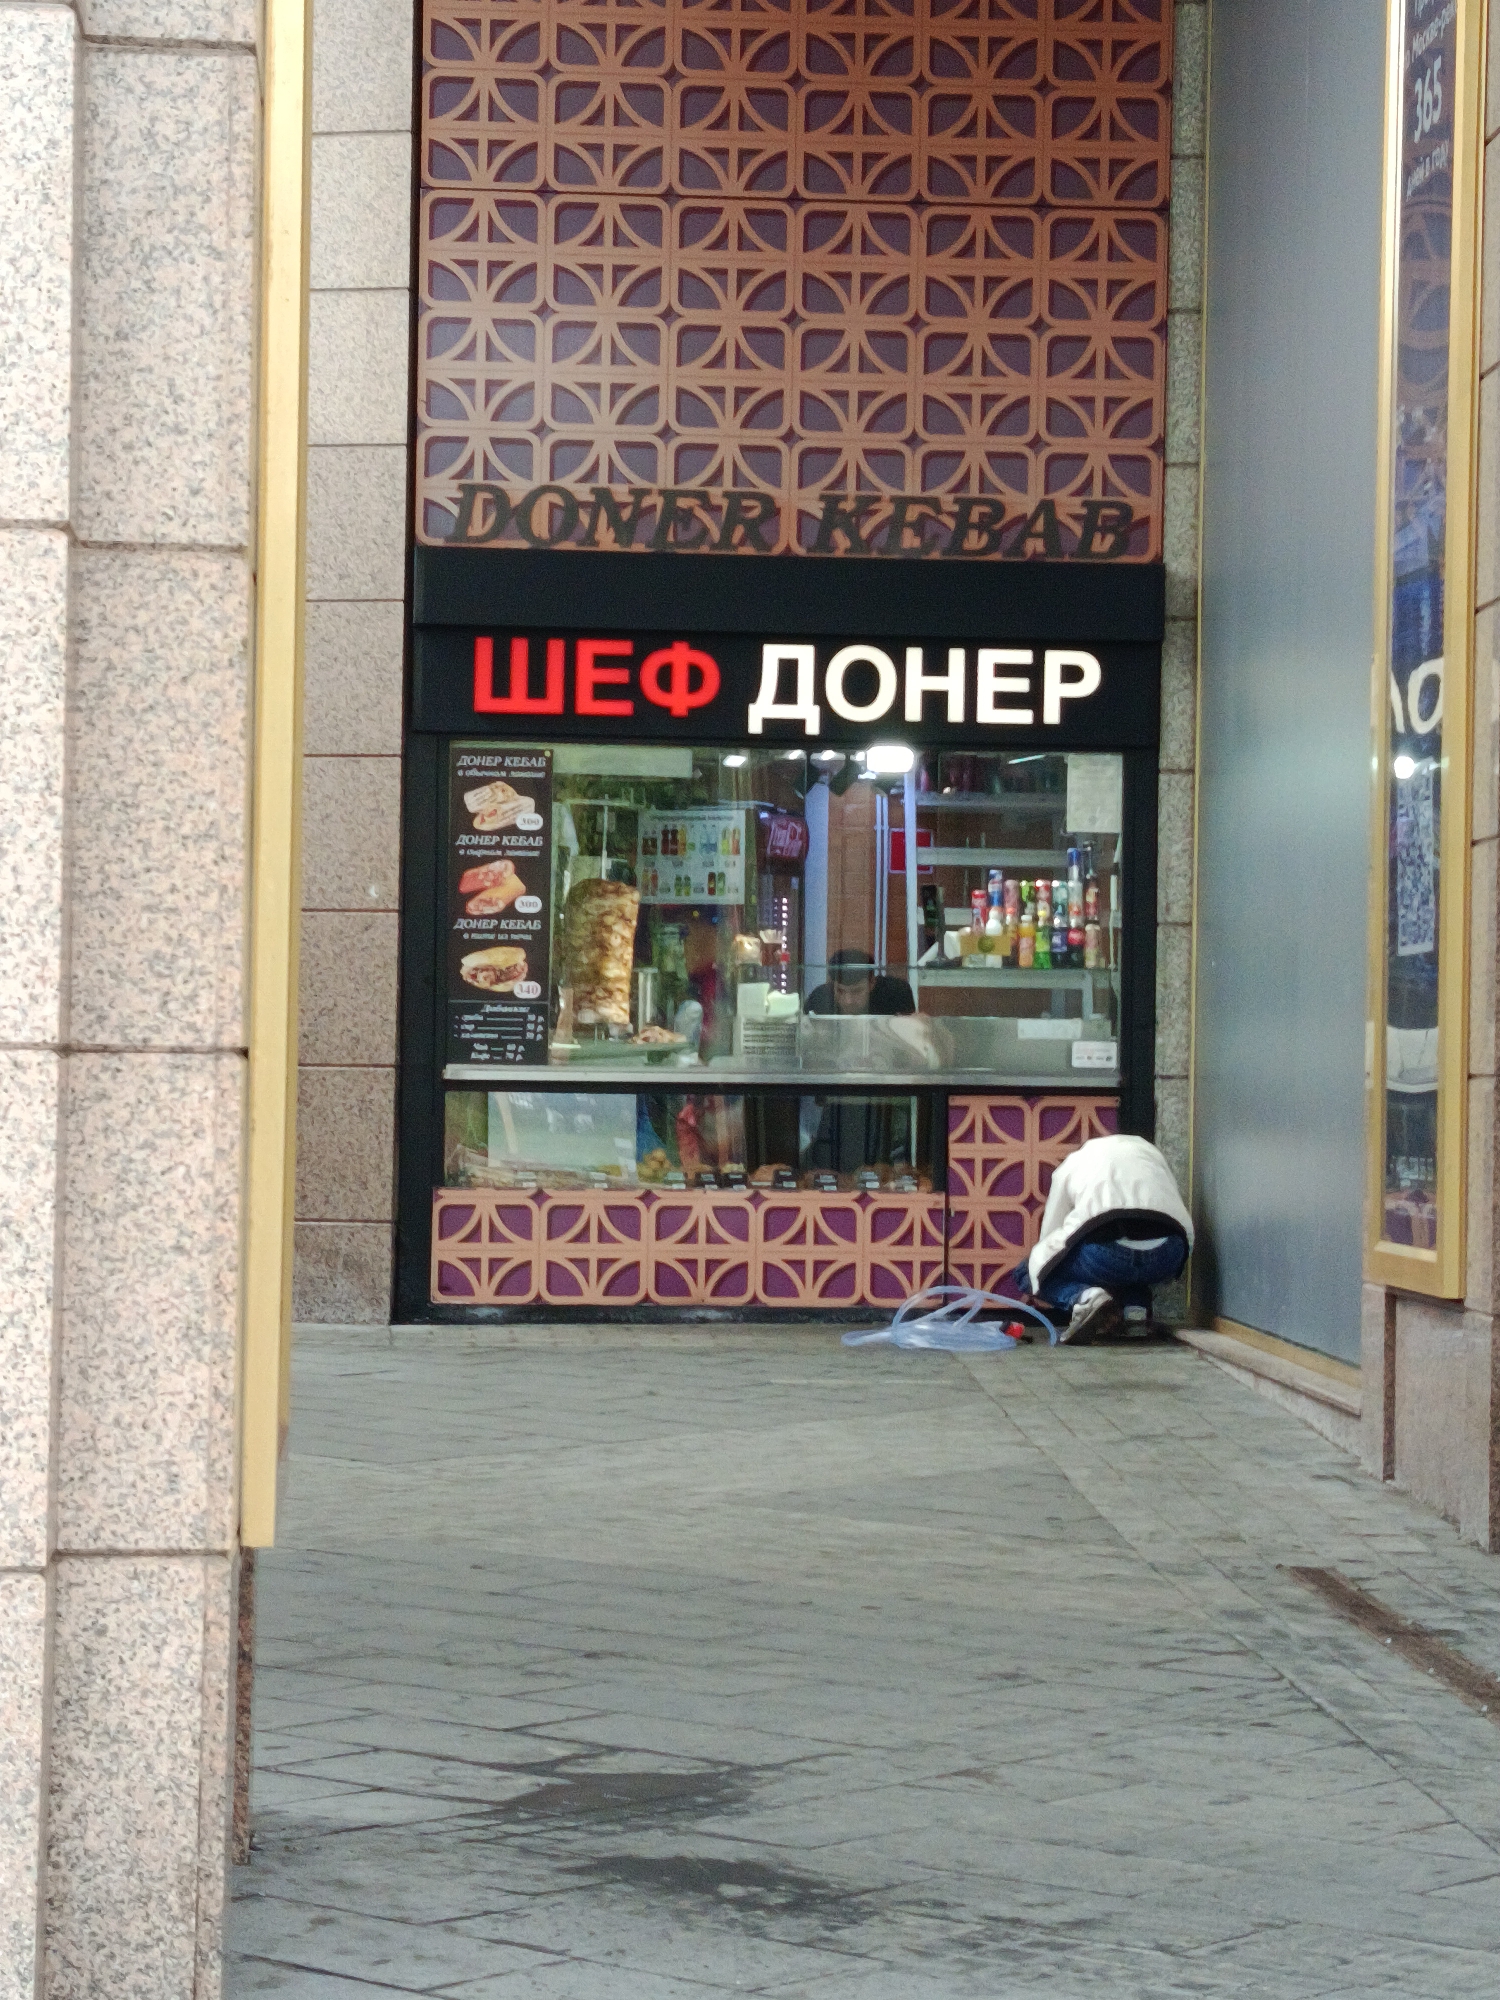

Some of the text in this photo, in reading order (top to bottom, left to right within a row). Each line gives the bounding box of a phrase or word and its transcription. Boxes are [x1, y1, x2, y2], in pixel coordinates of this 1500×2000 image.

[1414, 55, 1442, 143] 365
[446, 484, 1134, 559] DONER KEBAB
[474, 636, 1102, 736] ШЕФ ДОНЕР
[456, 755, 546, 768] ДОНЕР КЕБАБ
[454, 834, 543, 847] ДОНЕР КЕБАБ
[452, 918, 542, 931] ДОНЕР КЕБАБ
